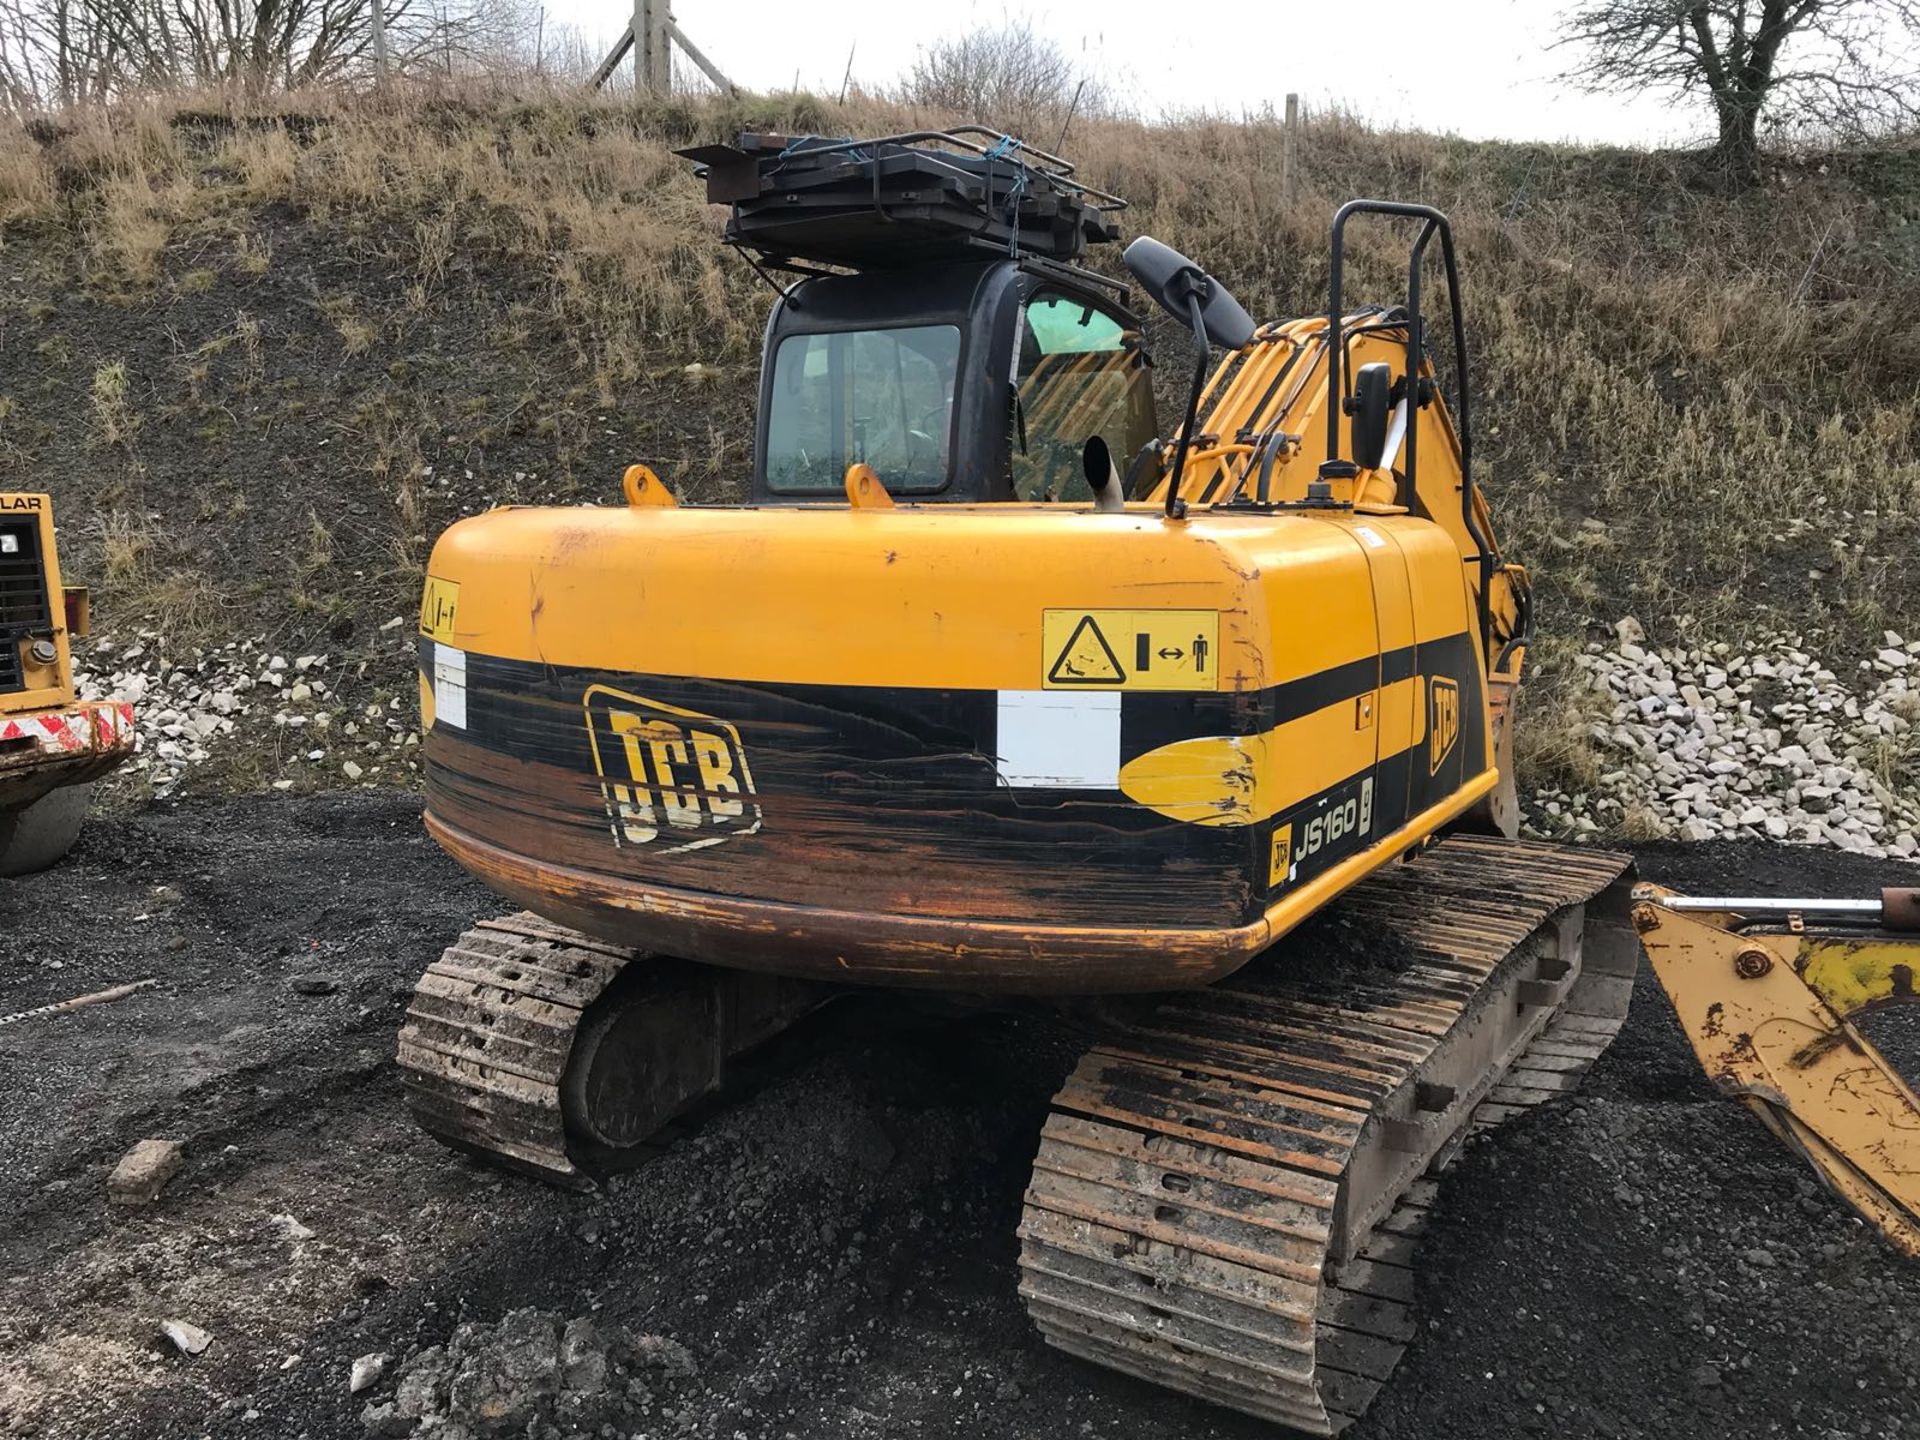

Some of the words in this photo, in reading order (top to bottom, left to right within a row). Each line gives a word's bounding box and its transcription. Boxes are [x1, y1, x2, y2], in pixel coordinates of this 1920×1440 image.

[1433, 687, 1457, 763] JCB
[608, 707, 743, 844] JCB
[1295, 798, 1357, 862] JS160
